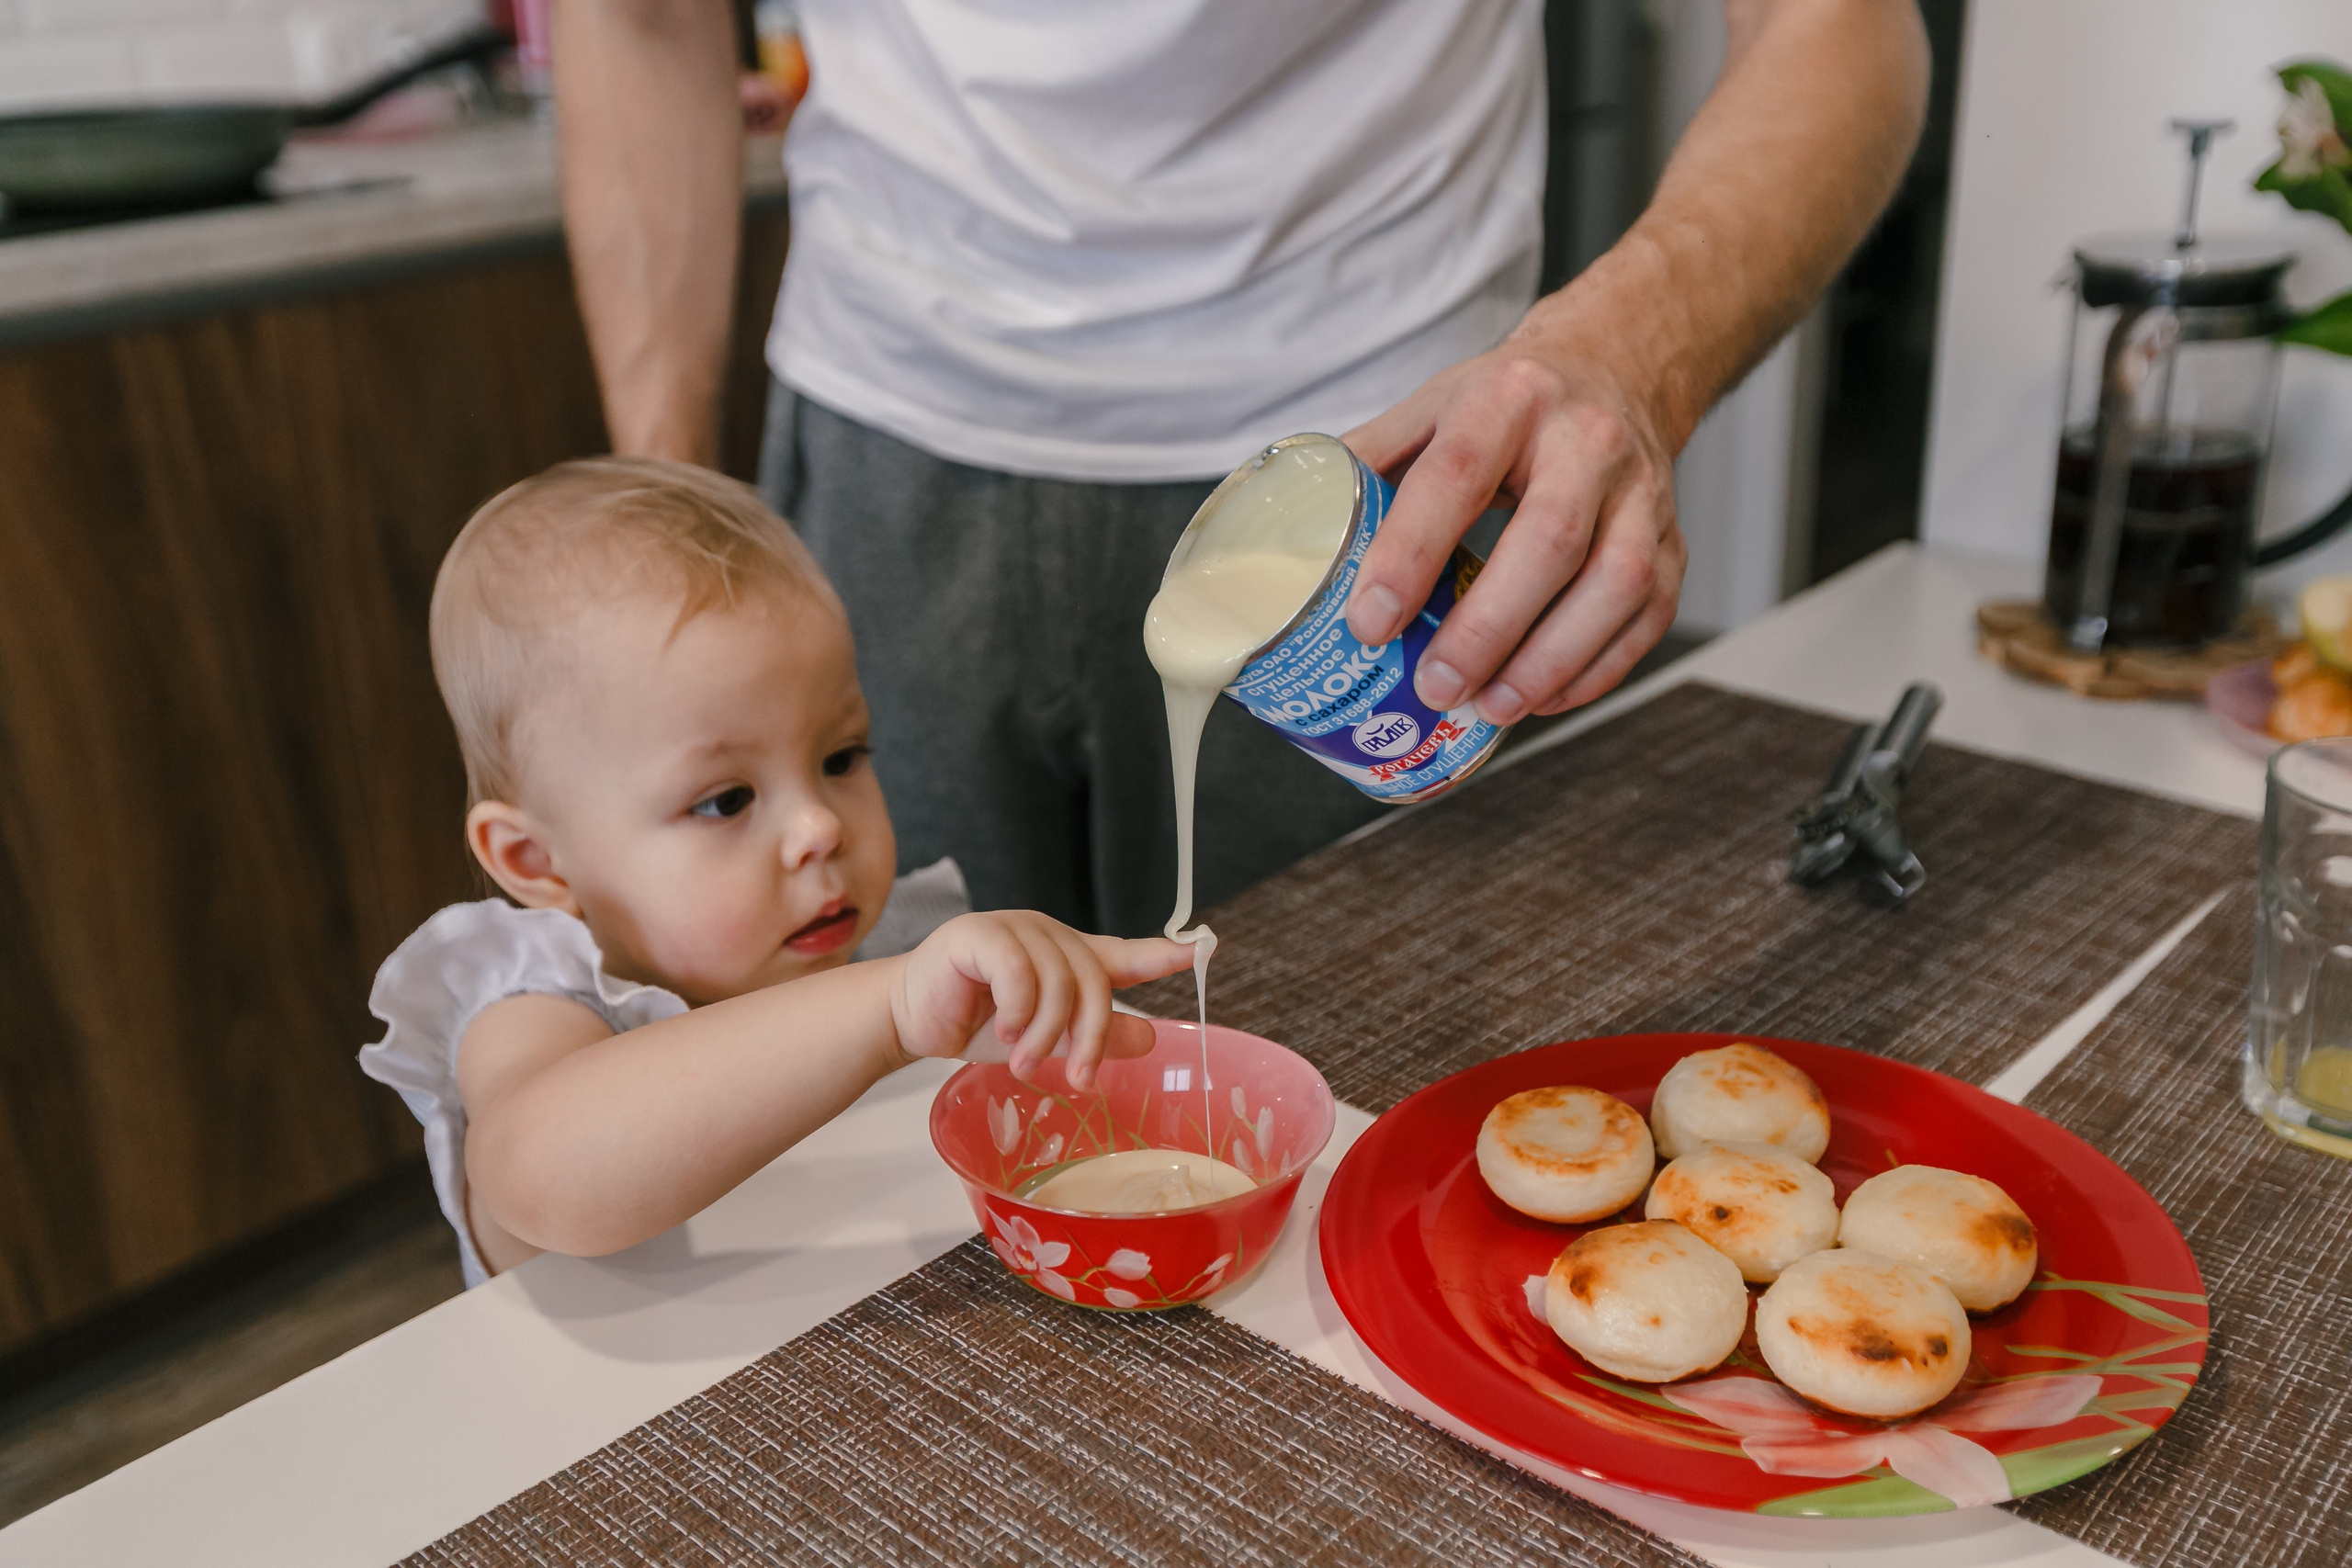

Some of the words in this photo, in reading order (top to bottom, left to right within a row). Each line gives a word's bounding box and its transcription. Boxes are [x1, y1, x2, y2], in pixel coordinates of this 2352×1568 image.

[1234, 669, 1265, 684] русь
[1262, 648, 1292, 670] ОАО
[1247, 628, 1342, 696] сгущенное
[1270, 649, 1345, 703] цельное
[1302, 720, 1334, 736] ГОСТ
[1331, 667, 1402, 726] 31688-2012
[1308, 664, 1385, 722] сахаром
